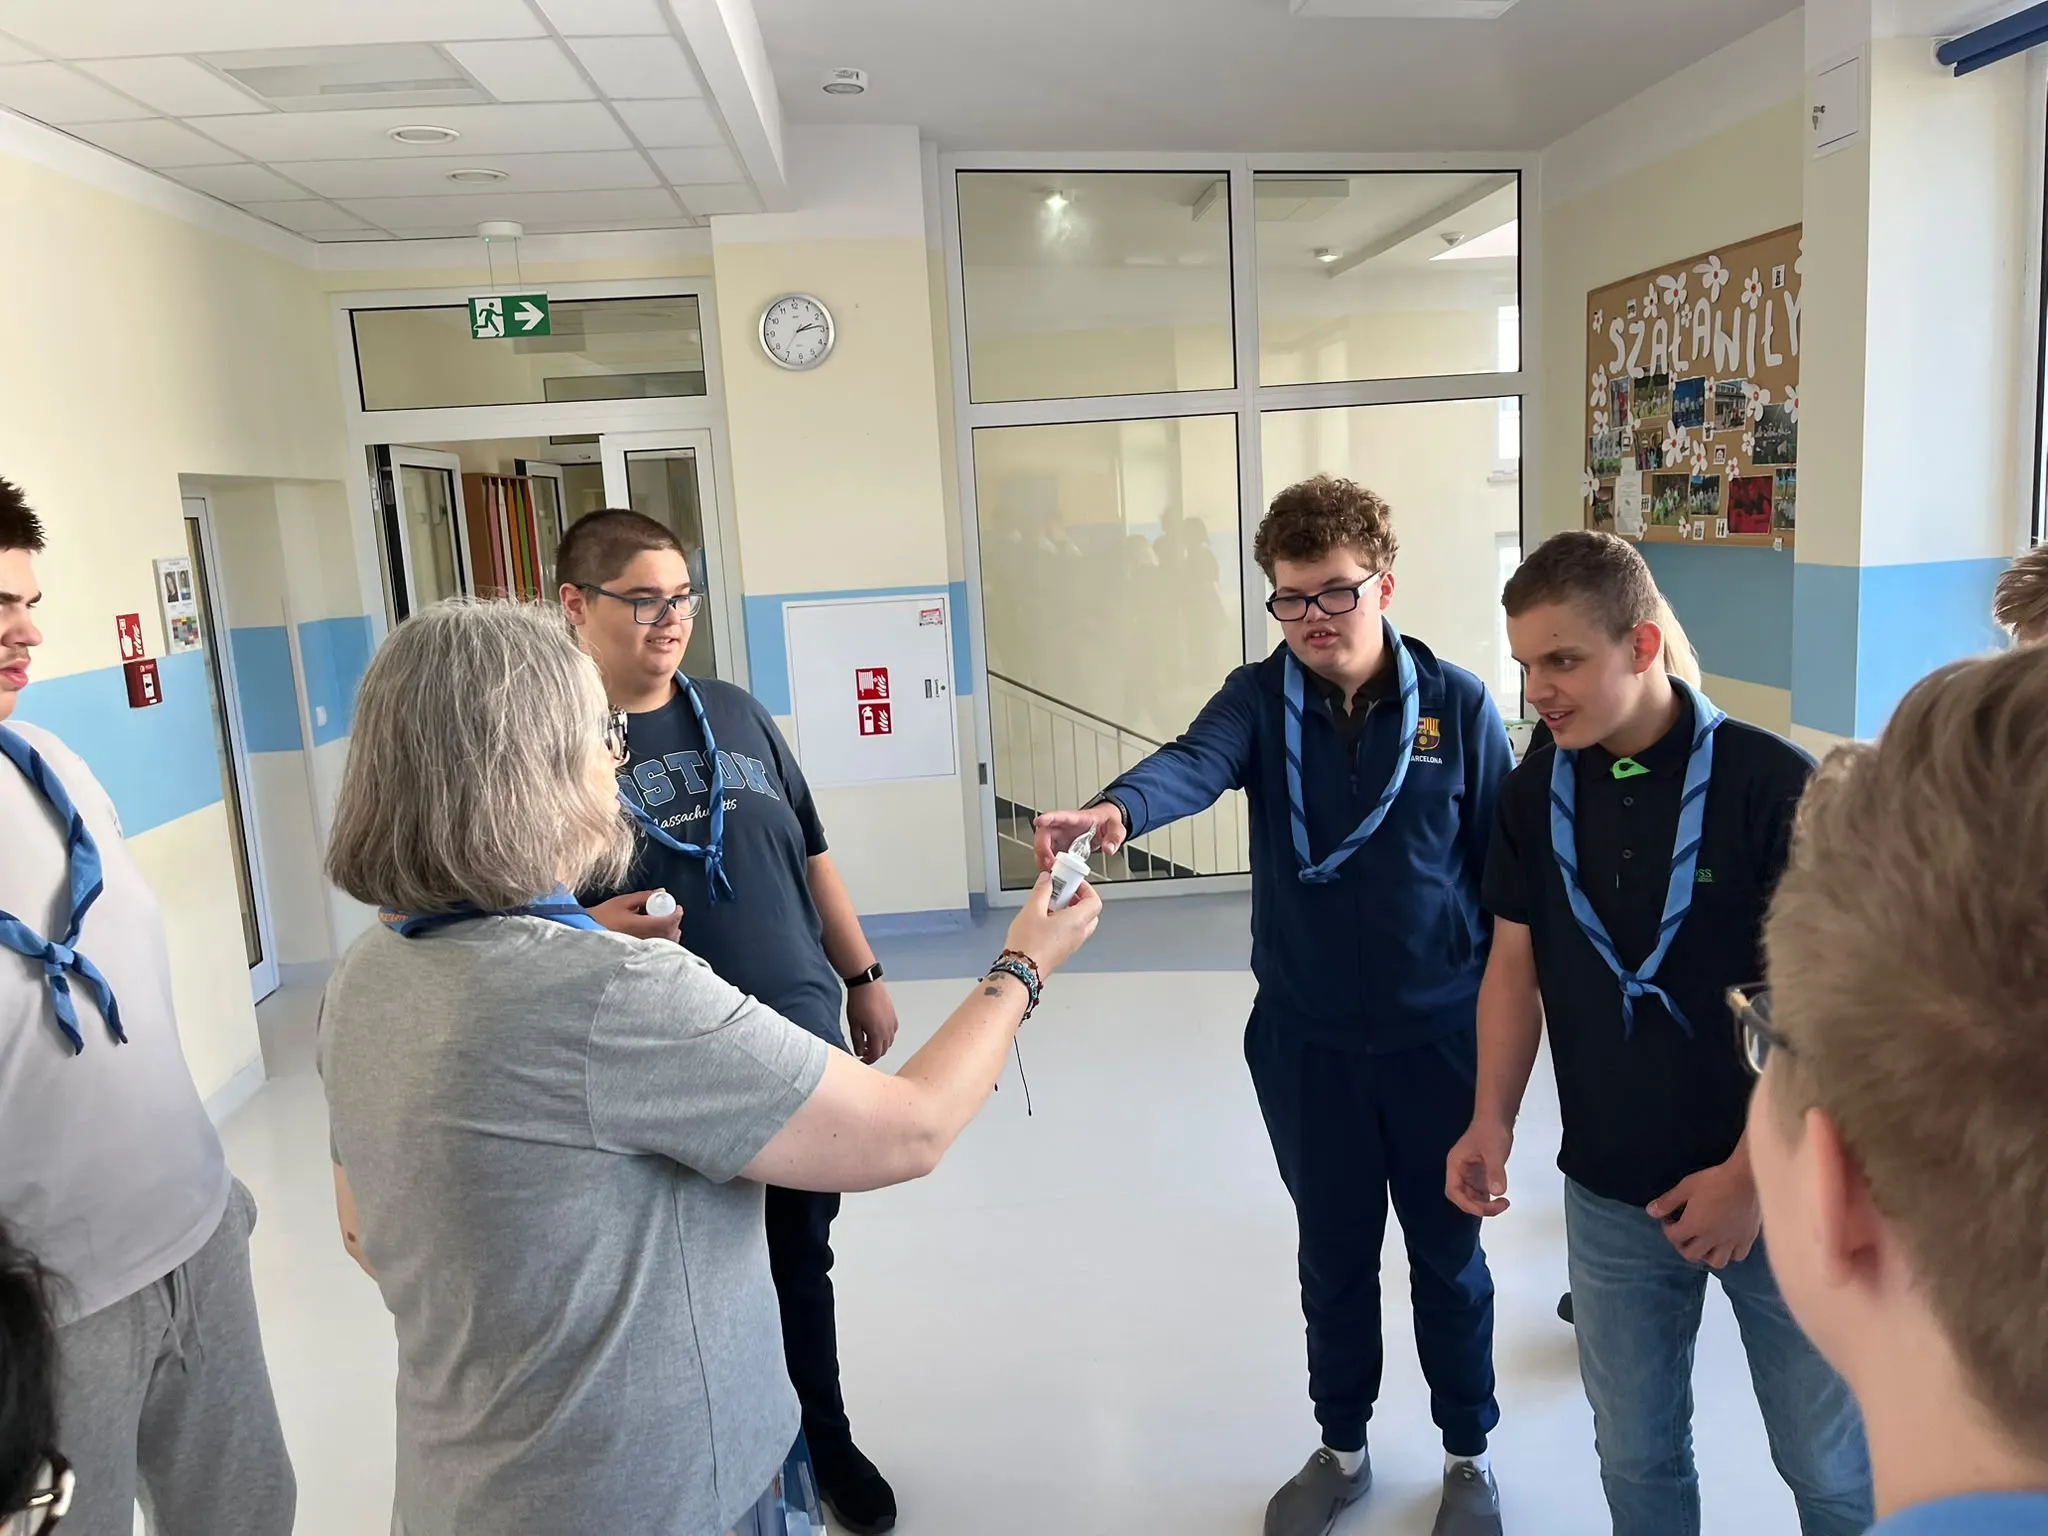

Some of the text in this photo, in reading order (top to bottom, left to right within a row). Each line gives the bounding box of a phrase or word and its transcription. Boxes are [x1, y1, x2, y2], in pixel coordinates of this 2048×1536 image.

[790, 302, 799, 310] 12
[780, 307, 787, 315] 11
[814, 312, 820, 321] 2
[771, 317, 780, 325] 10
[820, 325, 825, 333] 3
[1609, 287, 1801, 379] SZAŁAWIŁY
[770, 330, 776, 338] 9
[775, 342, 781, 350] 8
[785, 350, 791, 358] 7
[798, 352, 804, 360] 6
[810, 348, 816, 356] 5
[1410, 754, 1443, 764] ARCELONA
[616, 750, 780, 811] OSTON
[650, 799, 738, 831] assachutts
